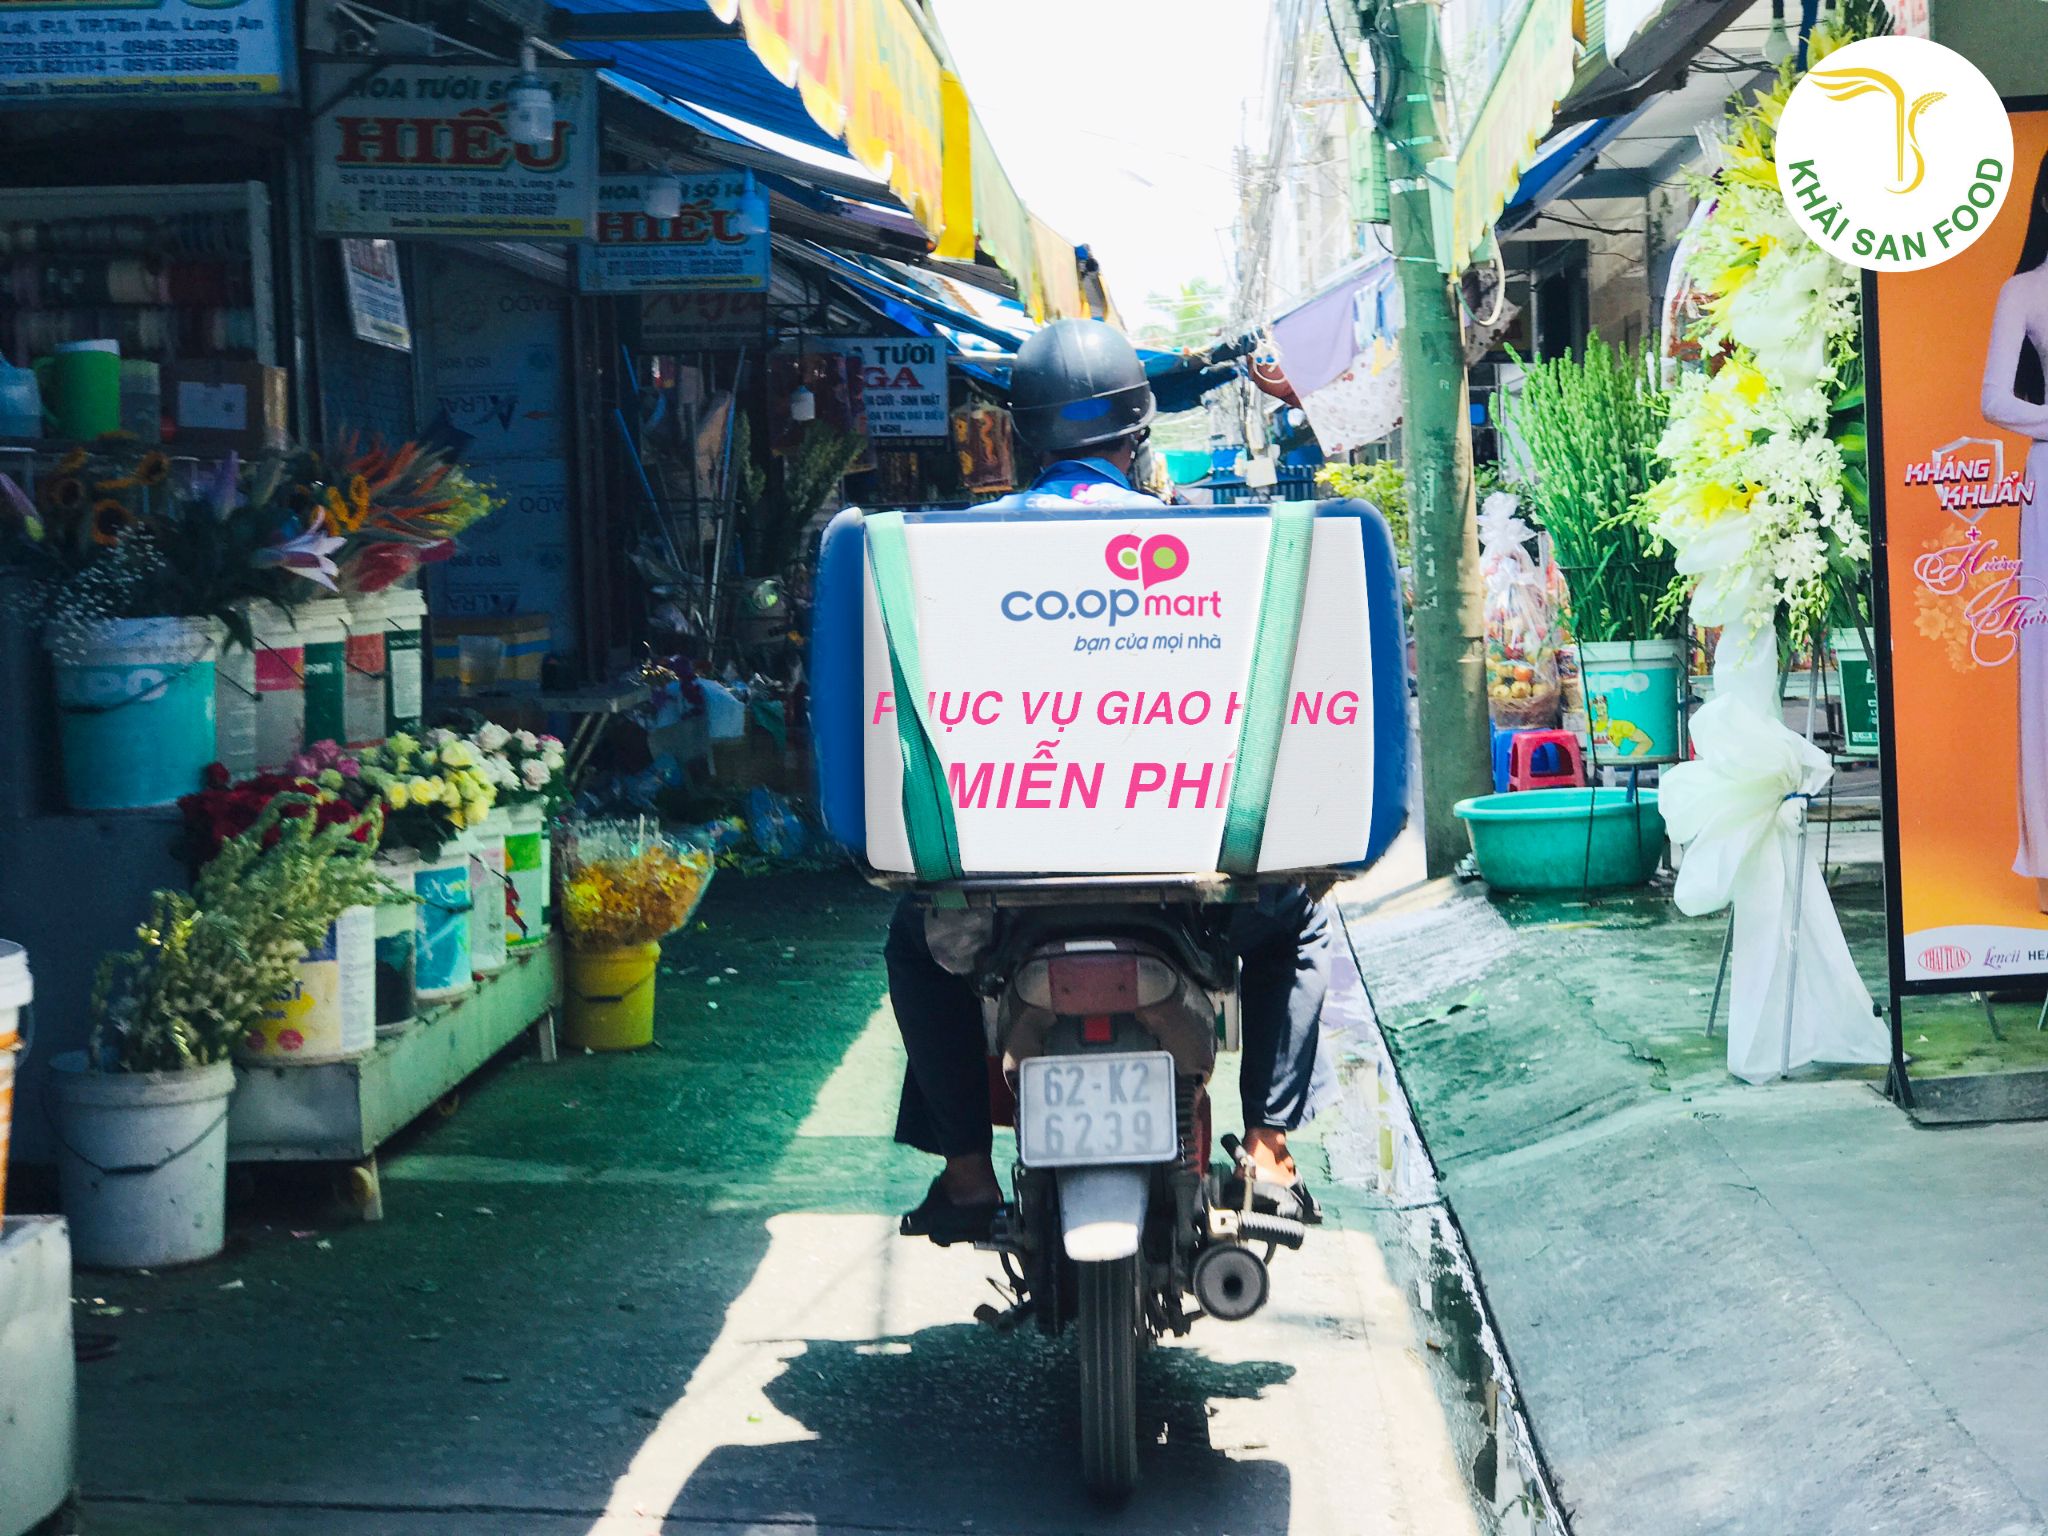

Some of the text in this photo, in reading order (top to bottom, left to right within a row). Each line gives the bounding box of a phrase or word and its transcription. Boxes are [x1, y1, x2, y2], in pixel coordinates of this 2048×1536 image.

[335, 102, 573, 169] HIẾU
[873, 343, 935, 365] TƯƠI
[1905, 455, 1991, 486] KHÁNG
[1941, 470, 2036, 511] KHUẨN
[1001, 588, 1222, 628] co.op mart
[1073, 632, 1222, 655] bạn của mọi nhà
[872, 690, 1360, 733] PỤC VỤ GIAO HNG
[948, 739, 1105, 809] MIỄN
[1044, 1109, 1154, 1158] 6239
